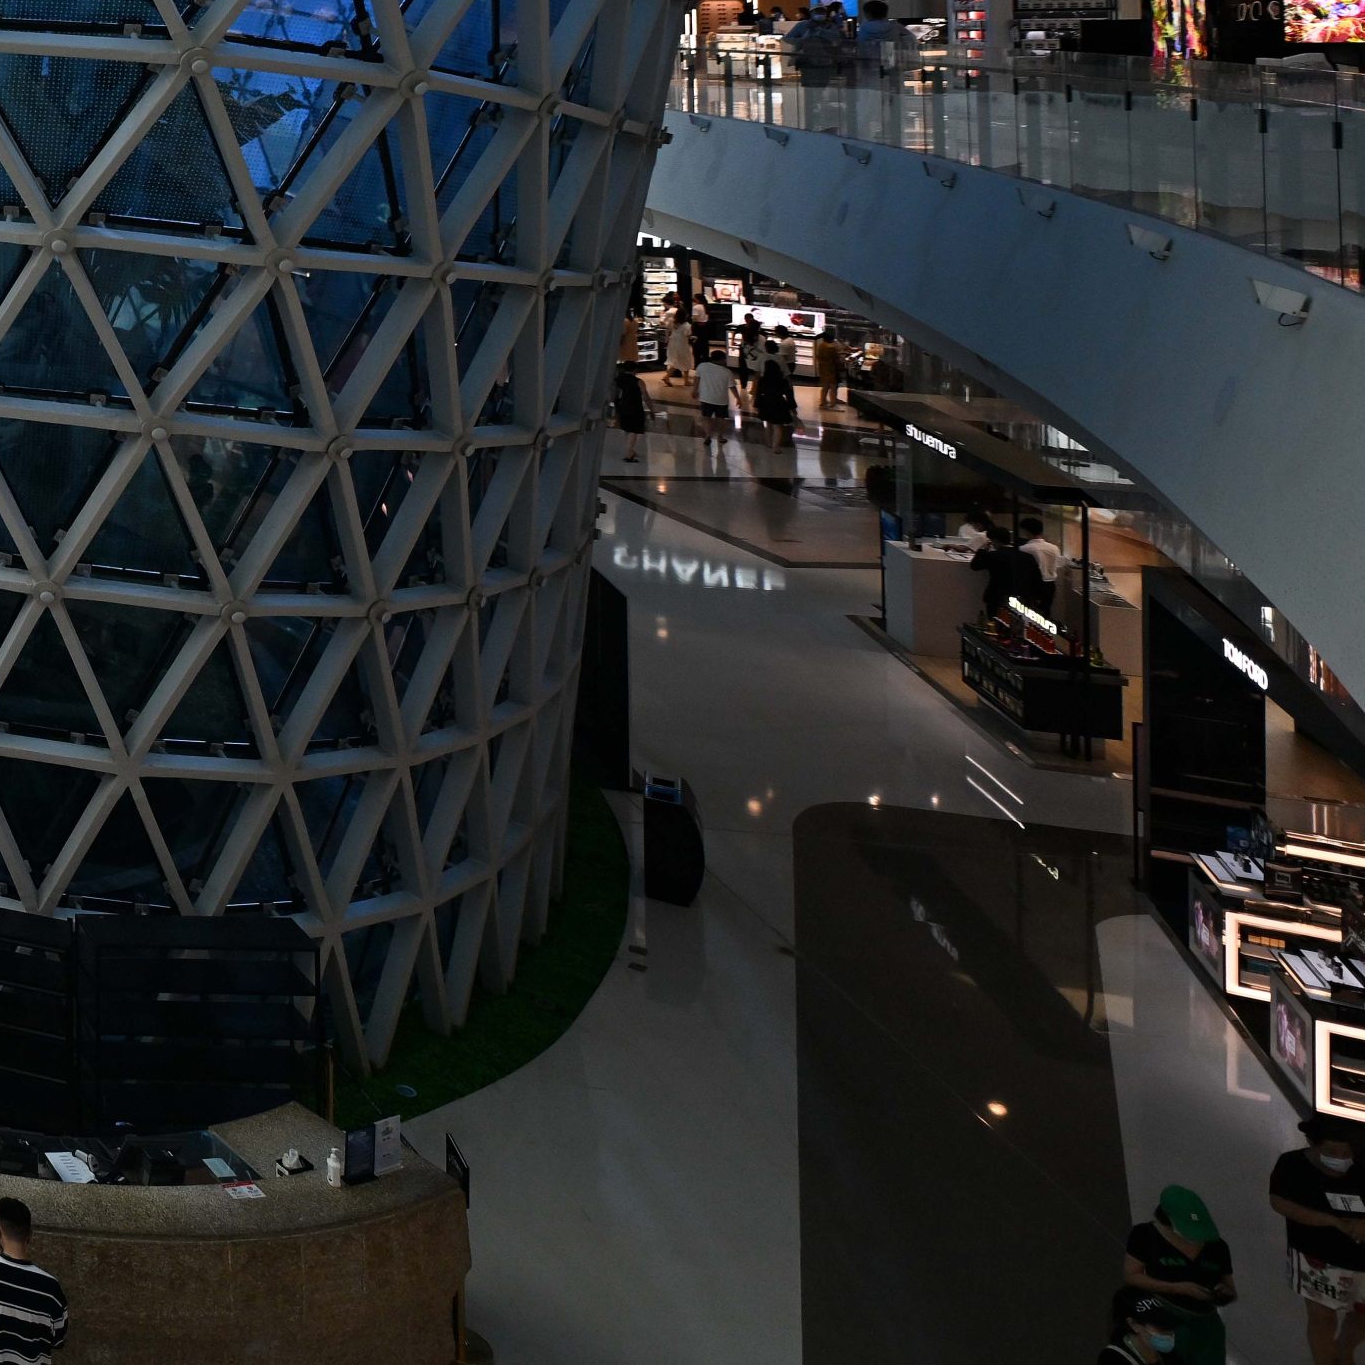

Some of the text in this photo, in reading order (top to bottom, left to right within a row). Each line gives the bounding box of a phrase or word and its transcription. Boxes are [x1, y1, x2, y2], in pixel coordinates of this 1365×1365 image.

[905, 423, 957, 459] shu uemura
[1024, 603, 1058, 635] uemura
[1222, 637, 1269, 691] TOM FORD
